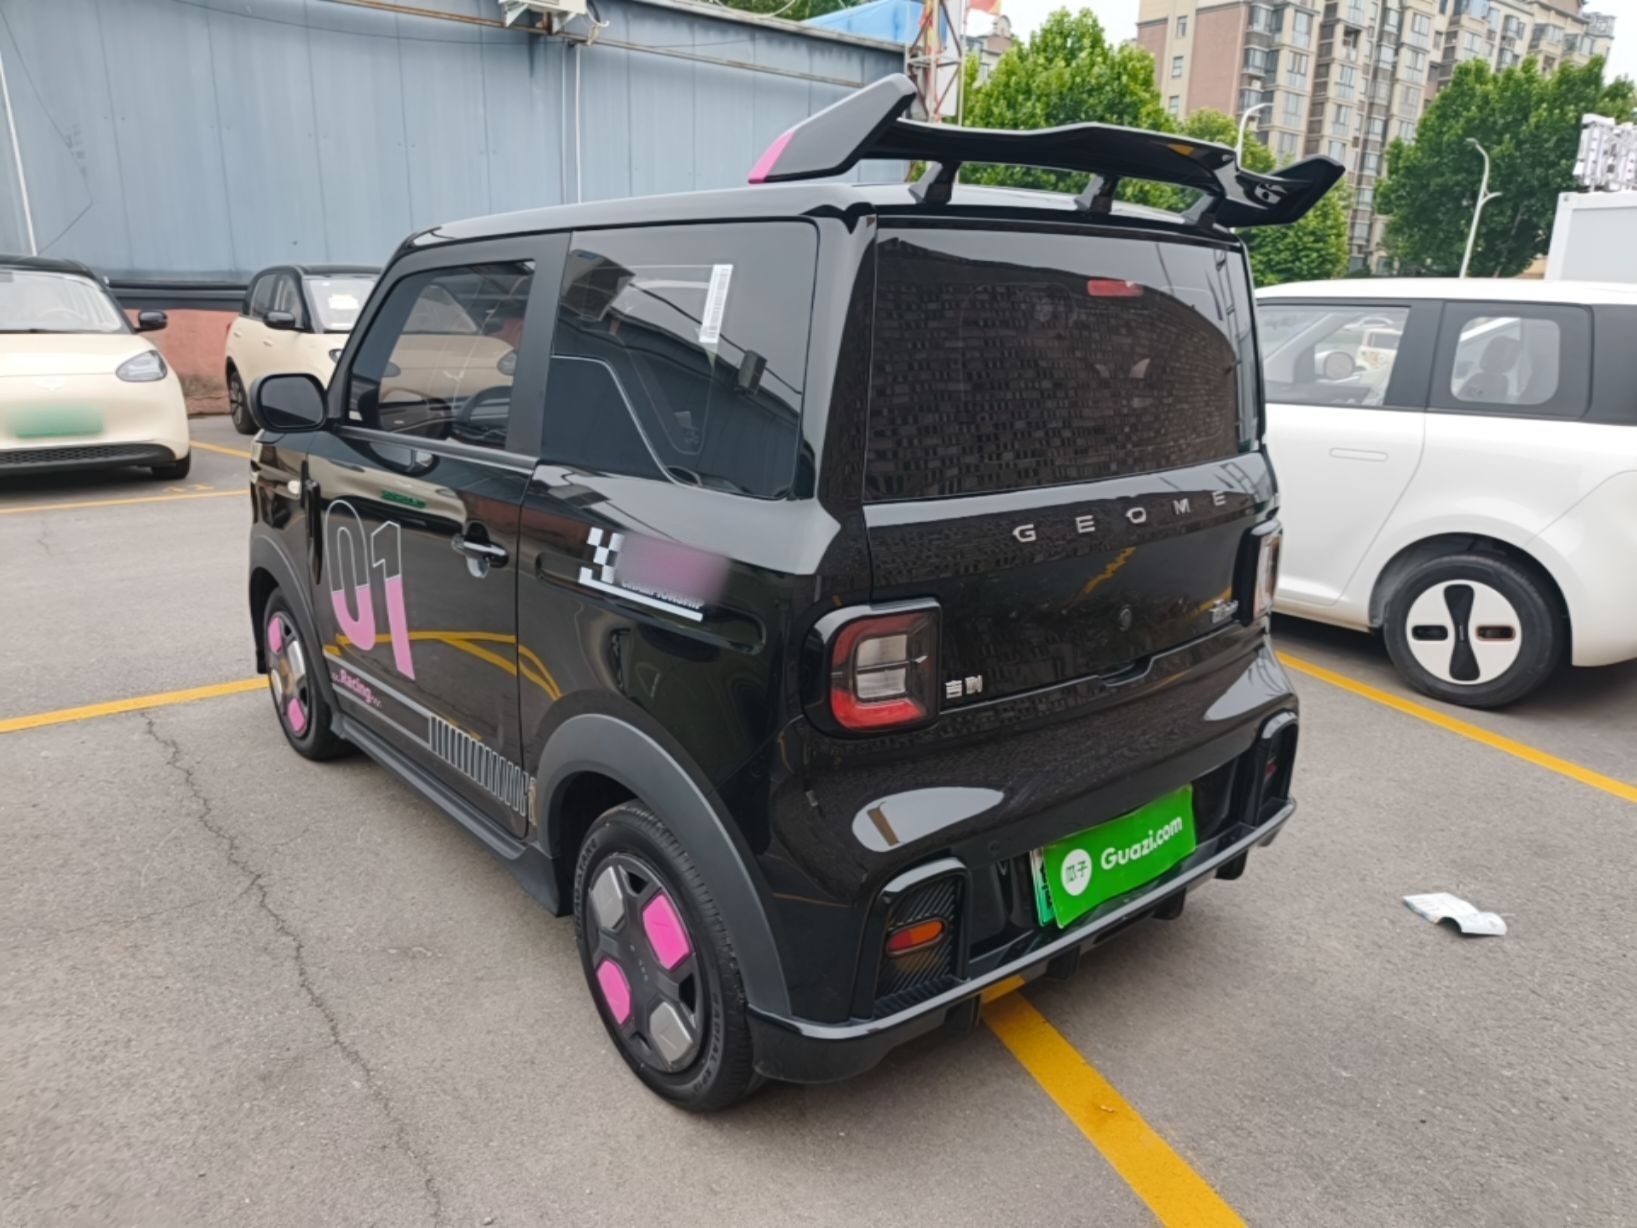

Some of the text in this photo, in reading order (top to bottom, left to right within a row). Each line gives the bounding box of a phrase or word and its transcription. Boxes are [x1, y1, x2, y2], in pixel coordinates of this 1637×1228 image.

[1012, 490, 1227, 543] GEOME
[324, 499, 416, 681] 01
[1100, 816, 1183, 870] Guazi.com
